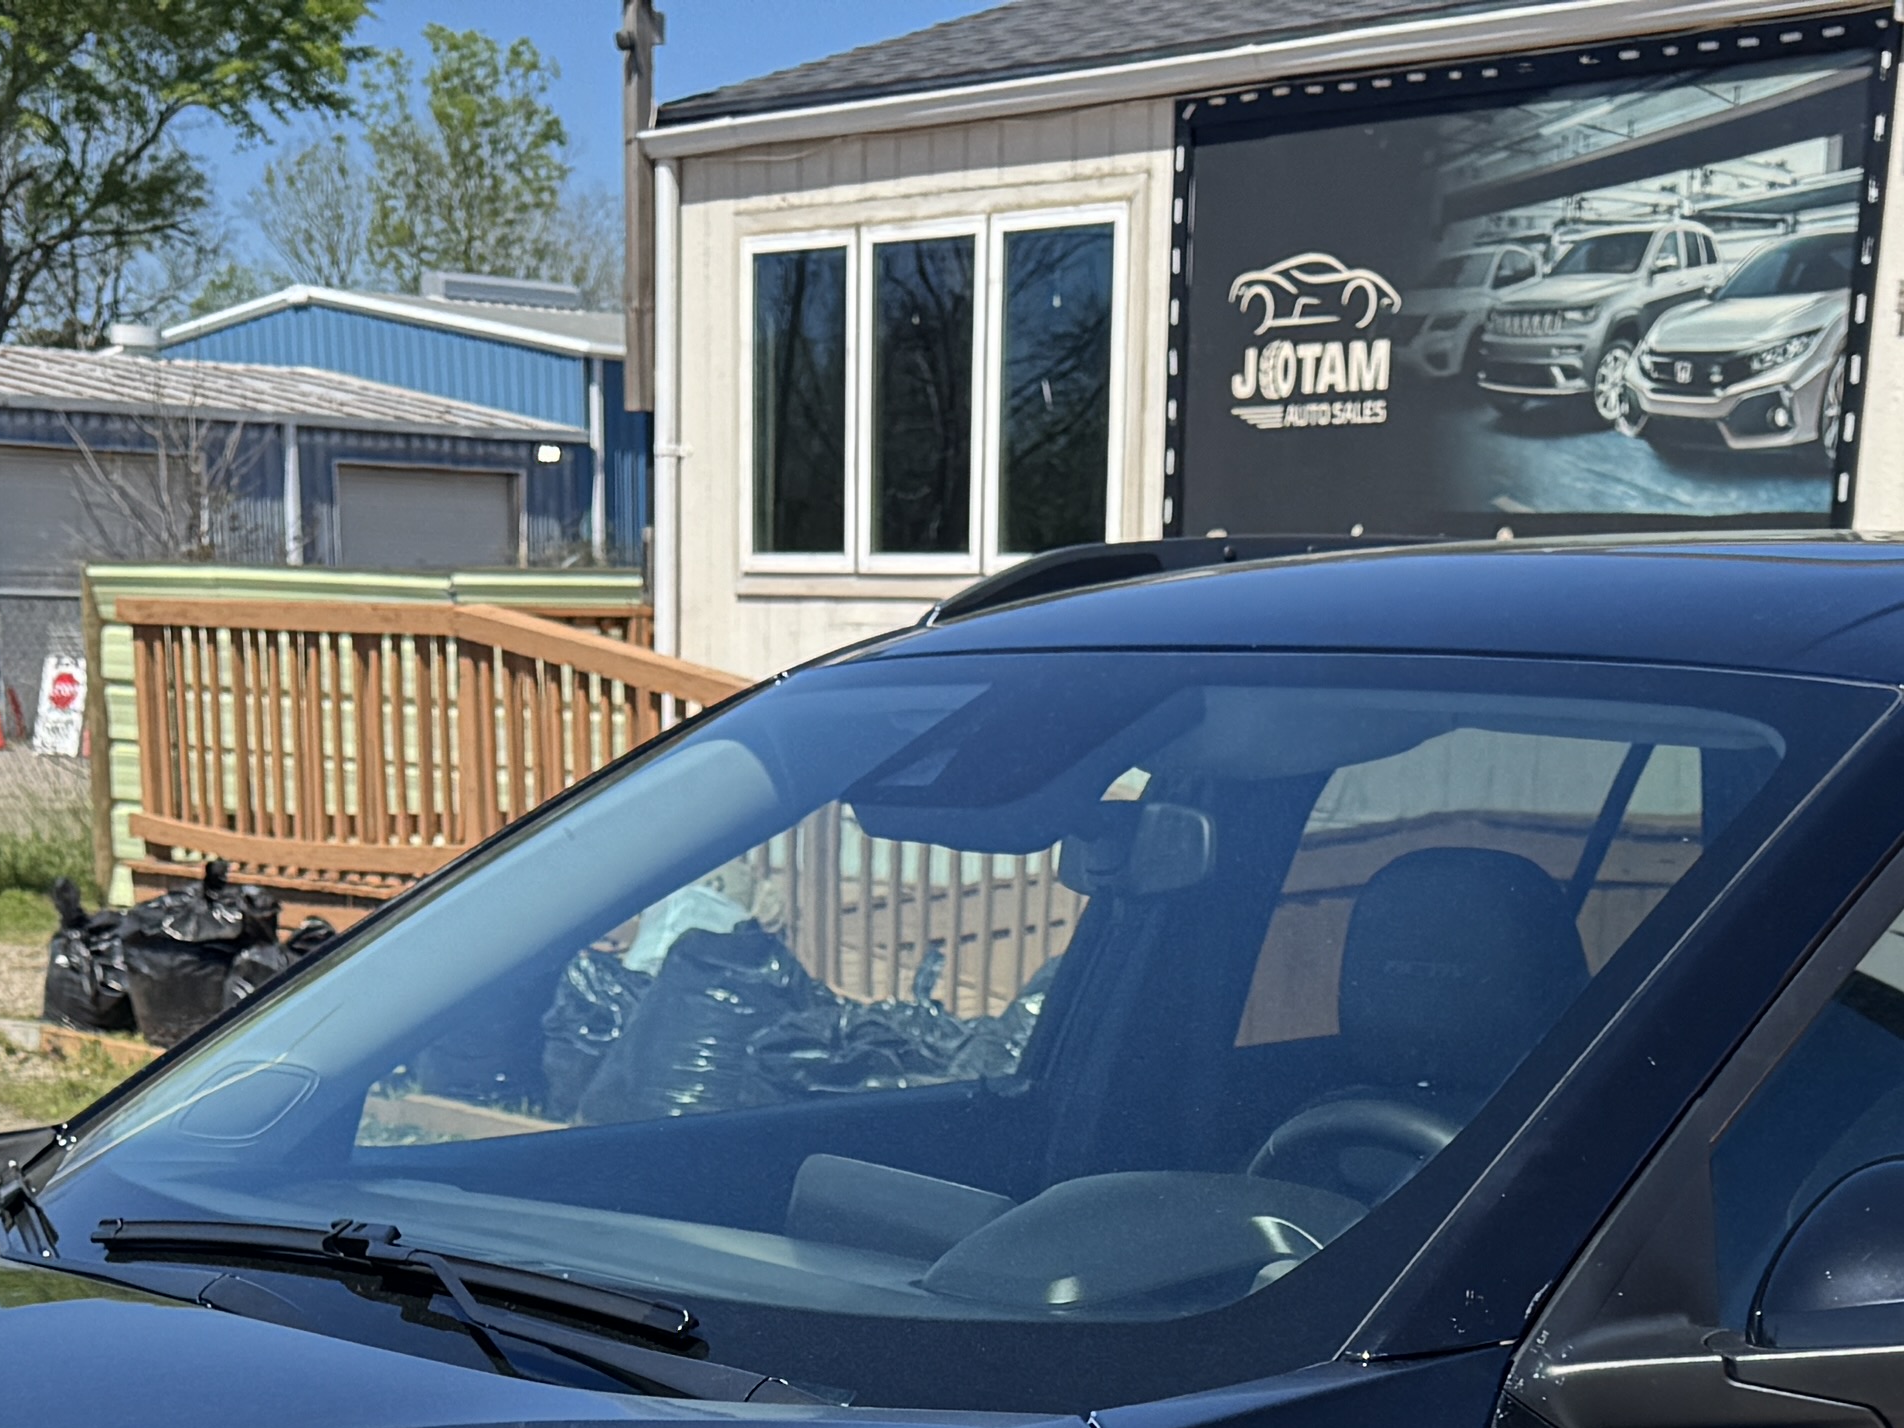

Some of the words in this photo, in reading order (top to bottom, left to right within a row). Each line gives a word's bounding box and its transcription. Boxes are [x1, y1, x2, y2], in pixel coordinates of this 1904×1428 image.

[1231, 339, 1392, 399] JOTAM
[1284, 403, 1332, 427] AUTO
[1332, 400, 1387, 425] SALES
